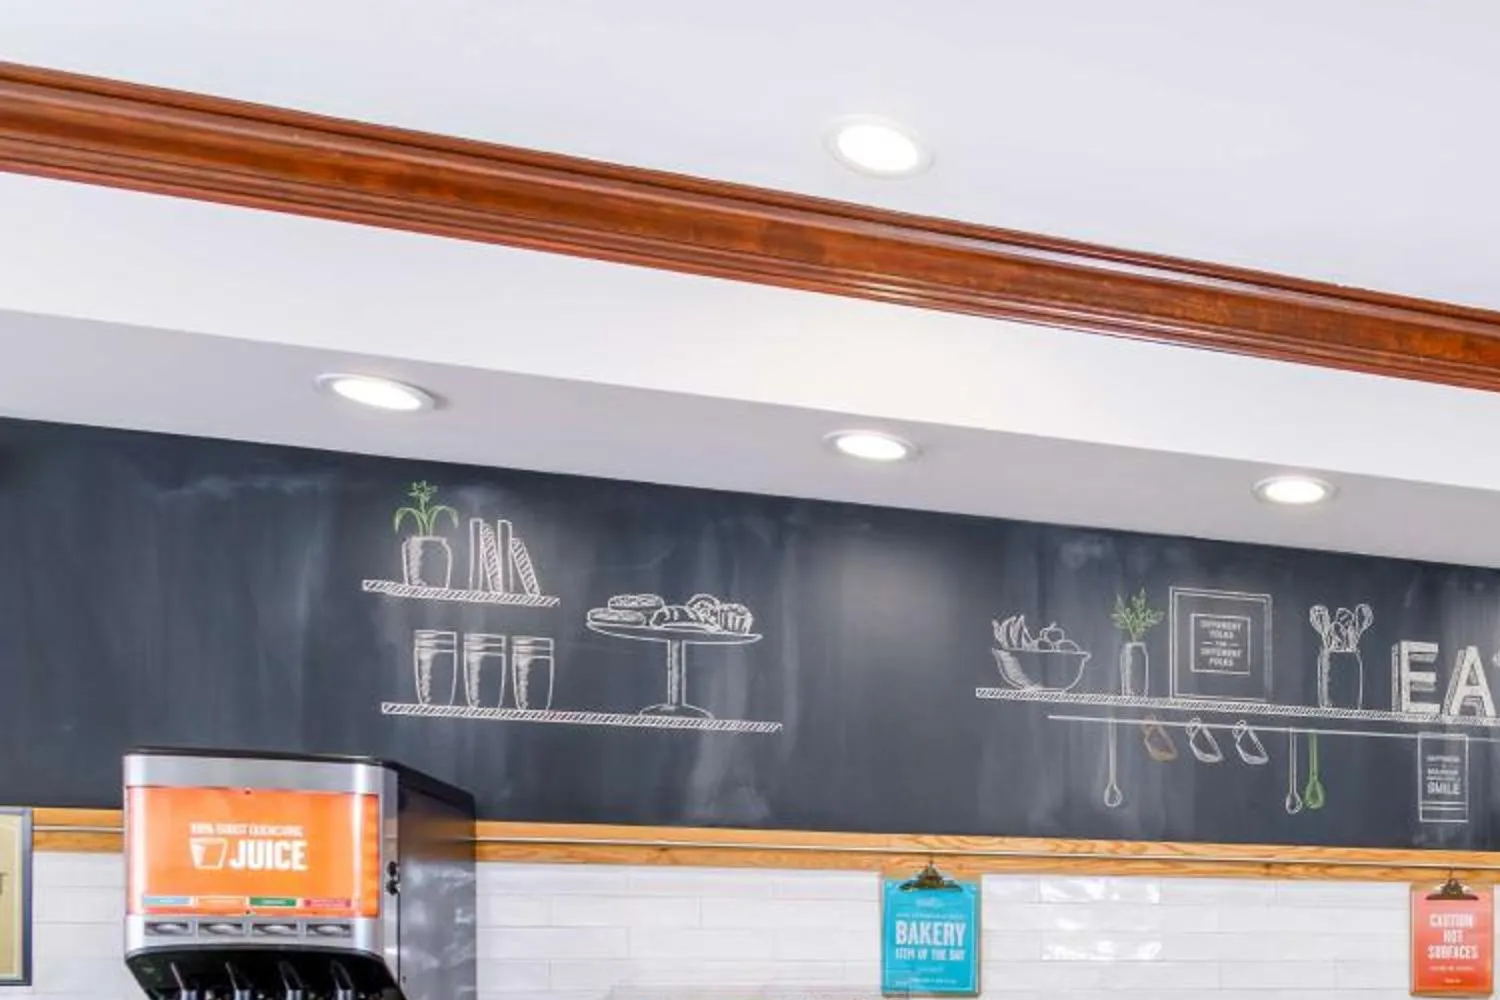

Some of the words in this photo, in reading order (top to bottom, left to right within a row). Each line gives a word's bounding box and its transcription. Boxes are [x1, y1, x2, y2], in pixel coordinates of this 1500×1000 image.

[1427, 781, 1461, 795] SMILE
[229, 839, 309, 871] JUICE
[1429, 914, 1473, 928] CAUTION
[895, 920, 967, 947] BAKERY
[1443, 929, 1464, 943] HOT
[1427, 945, 1479, 960] SURFACES
